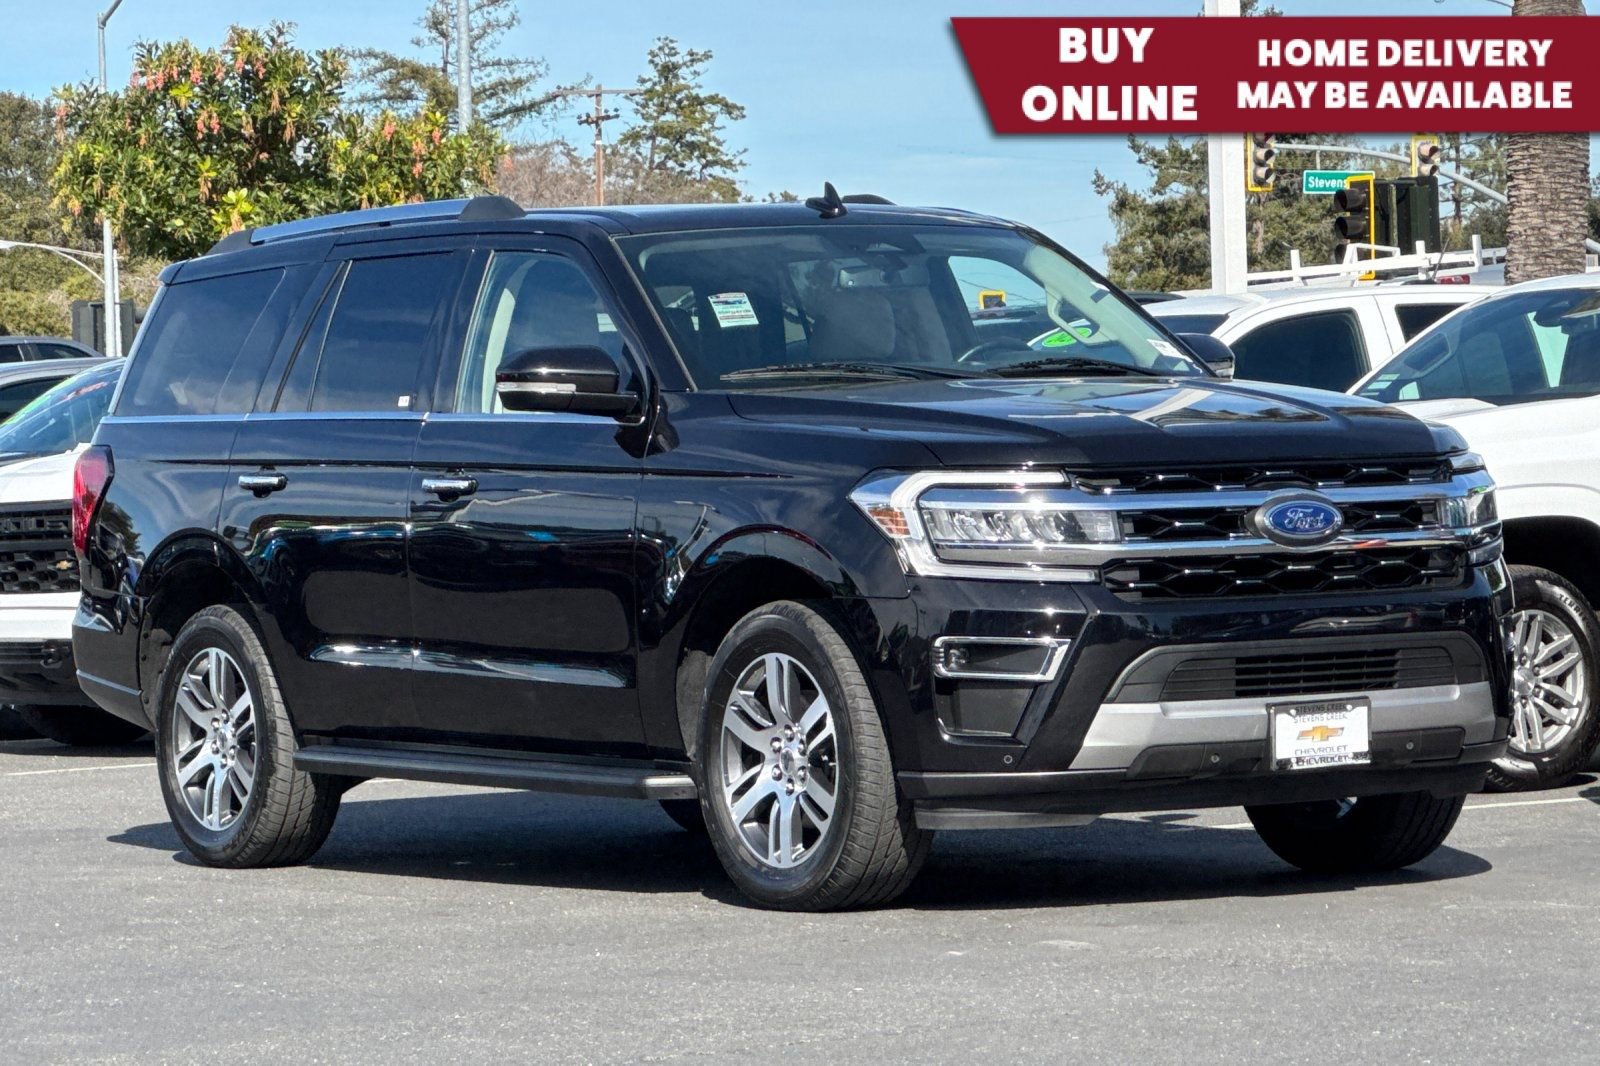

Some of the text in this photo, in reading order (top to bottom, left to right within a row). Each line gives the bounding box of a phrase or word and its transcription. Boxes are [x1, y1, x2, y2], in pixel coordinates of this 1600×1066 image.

[1284, 507, 1325, 529] Ford
[1295, 704, 1325, 714] STEVENS
[1294, 713, 1324, 723] STEVENS
[1294, 745, 1348, 756] CHEVROLET
